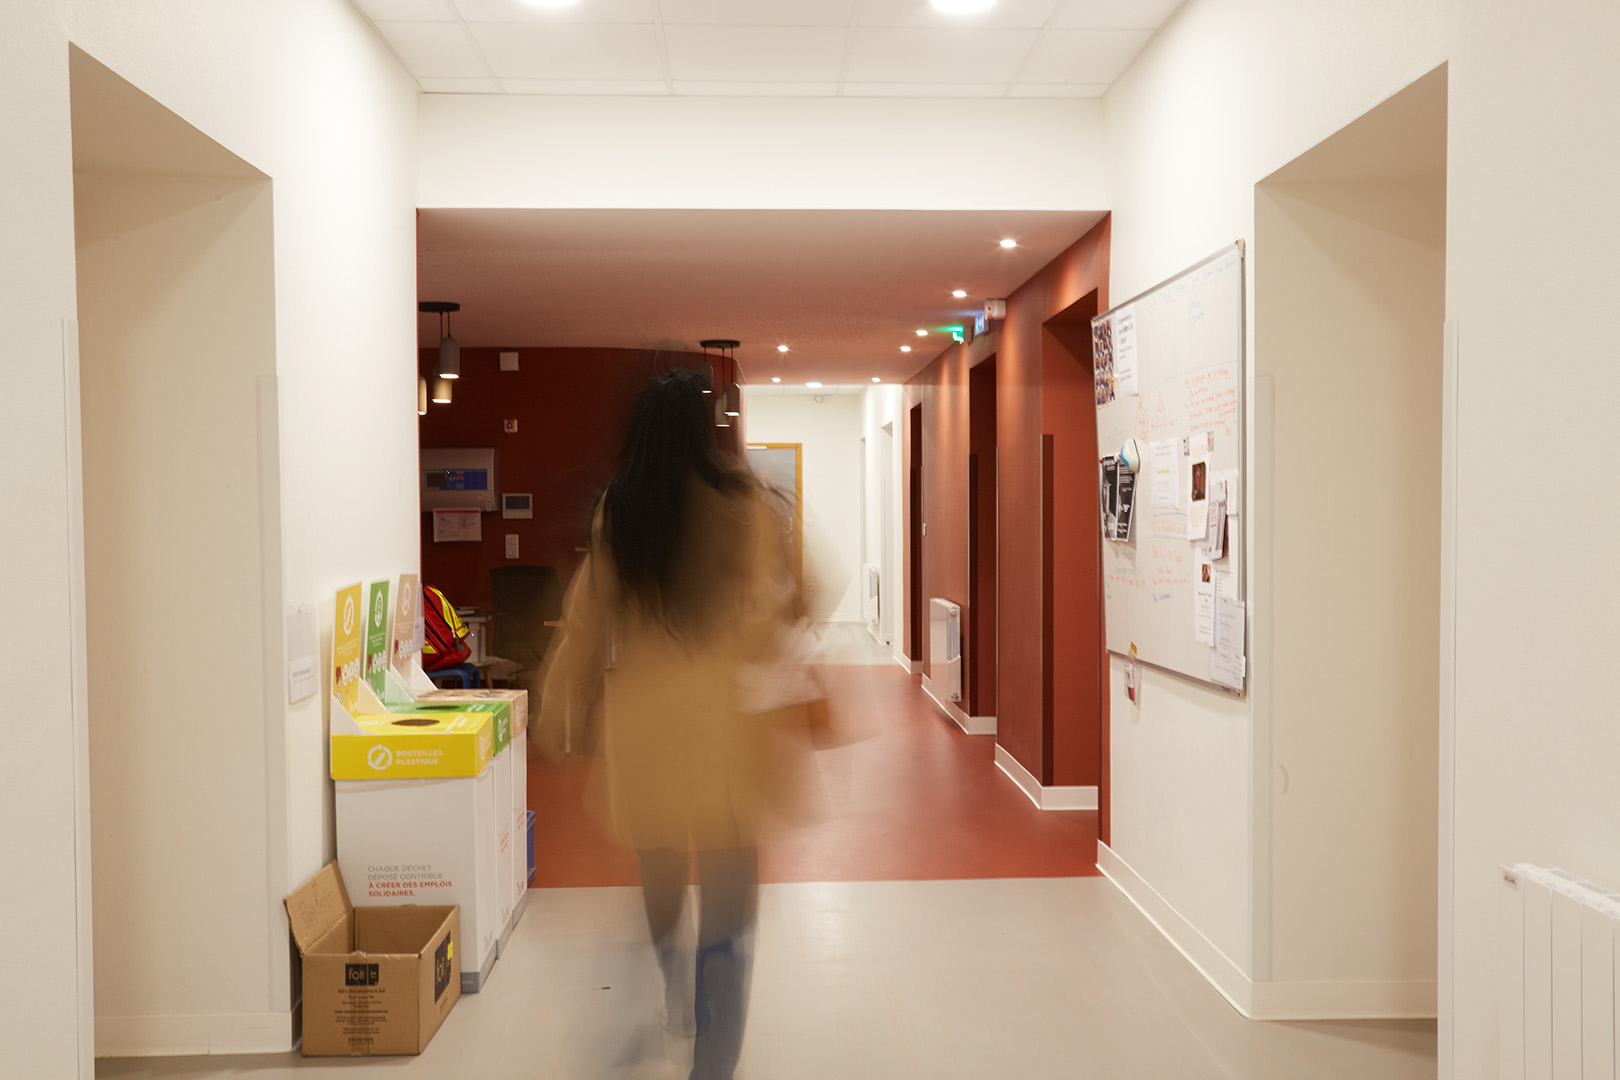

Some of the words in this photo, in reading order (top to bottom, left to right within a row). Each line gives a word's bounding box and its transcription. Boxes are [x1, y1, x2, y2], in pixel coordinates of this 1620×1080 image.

[396, 750, 443, 758] BOUTEILLES
[396, 758, 439, 766] PLASTIQUE
[367, 865, 400, 873] CHAQUE
[401, 864, 432, 872] DÉCHET
[367, 872, 399, 880] DÉPOSÉ
[400, 872, 444, 880] CONTRIBUE
[368, 881, 374, 889] À
[376, 880, 401, 889] CRÉER
[420, 880, 453, 888] EMPLOIS
[368, 890, 416, 898] SOLIDAIRES.
